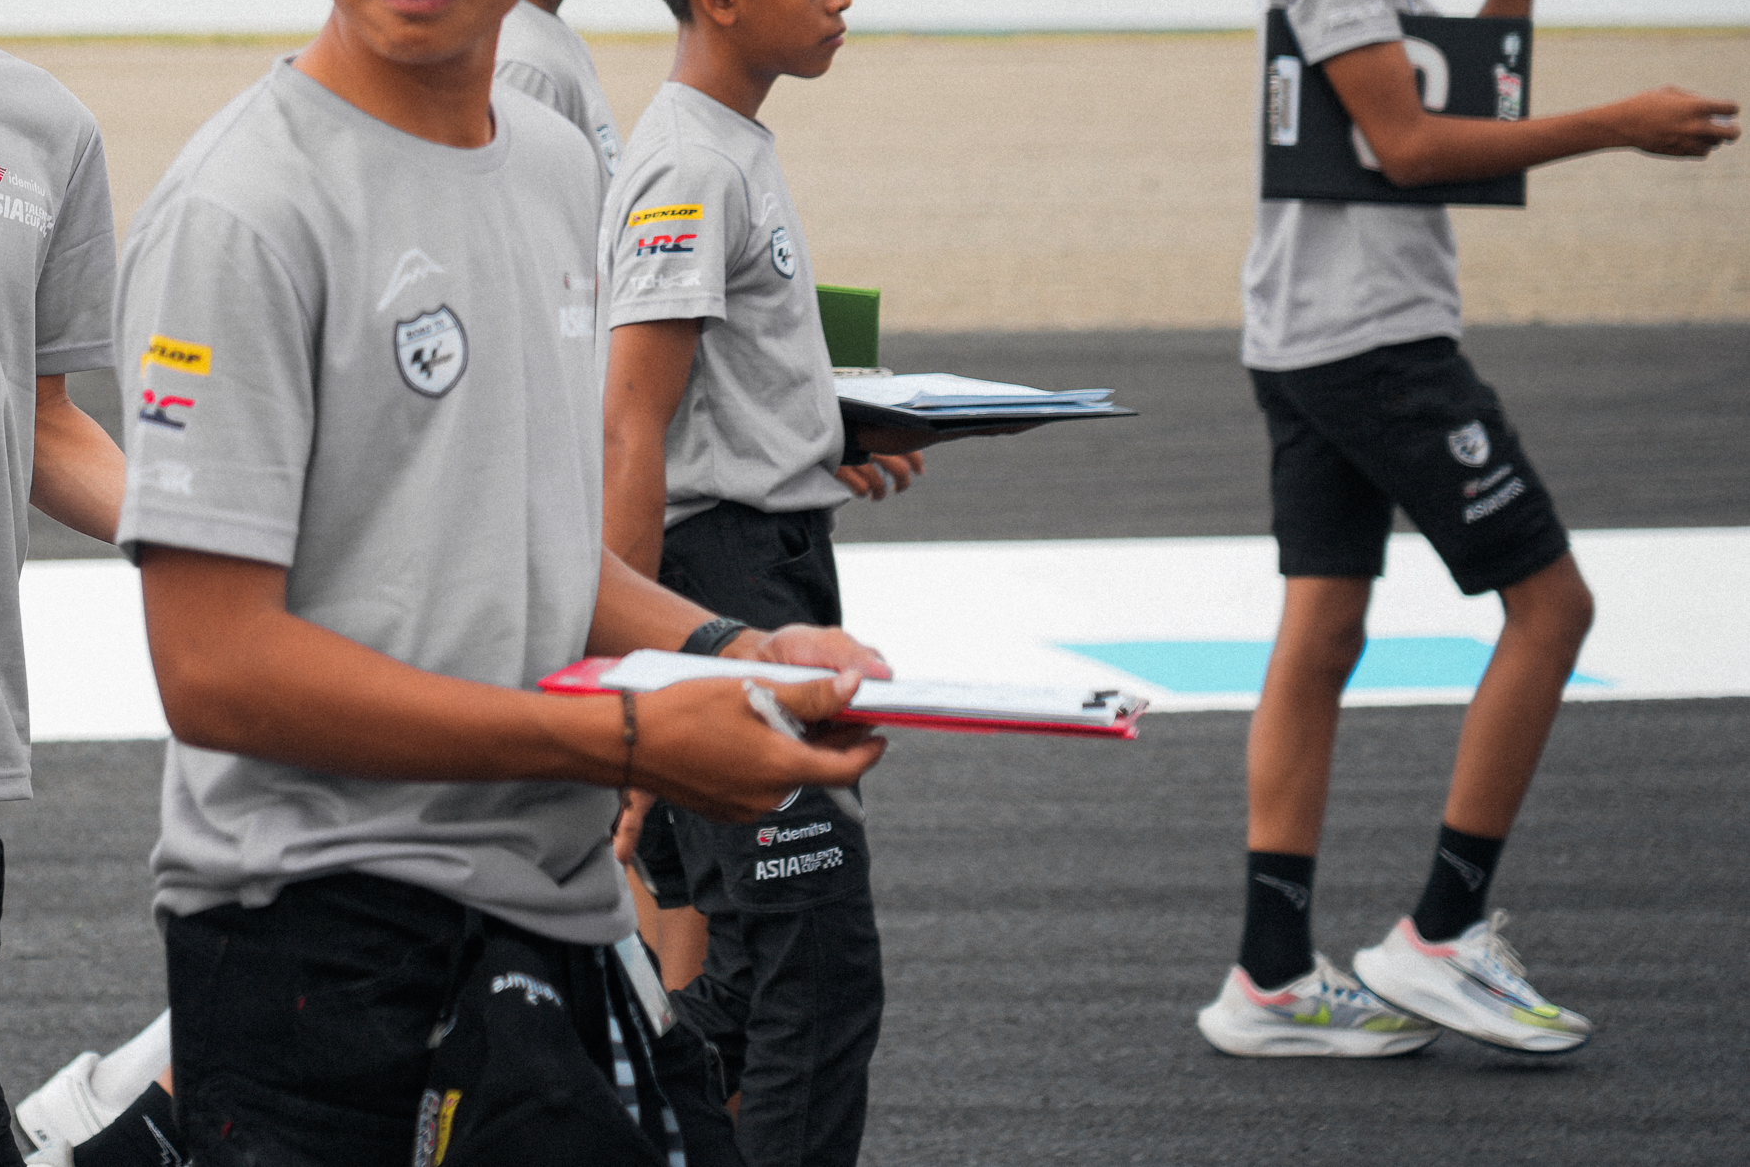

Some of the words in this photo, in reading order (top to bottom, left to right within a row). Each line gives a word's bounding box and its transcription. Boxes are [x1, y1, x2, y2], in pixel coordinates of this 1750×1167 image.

[643, 208, 698, 221] DUNLOP
[636, 233, 698, 257] HRC
[776, 821, 833, 844] idemitsu
[755, 856, 801, 881] ASIA
[801, 860, 822, 873] CUP
